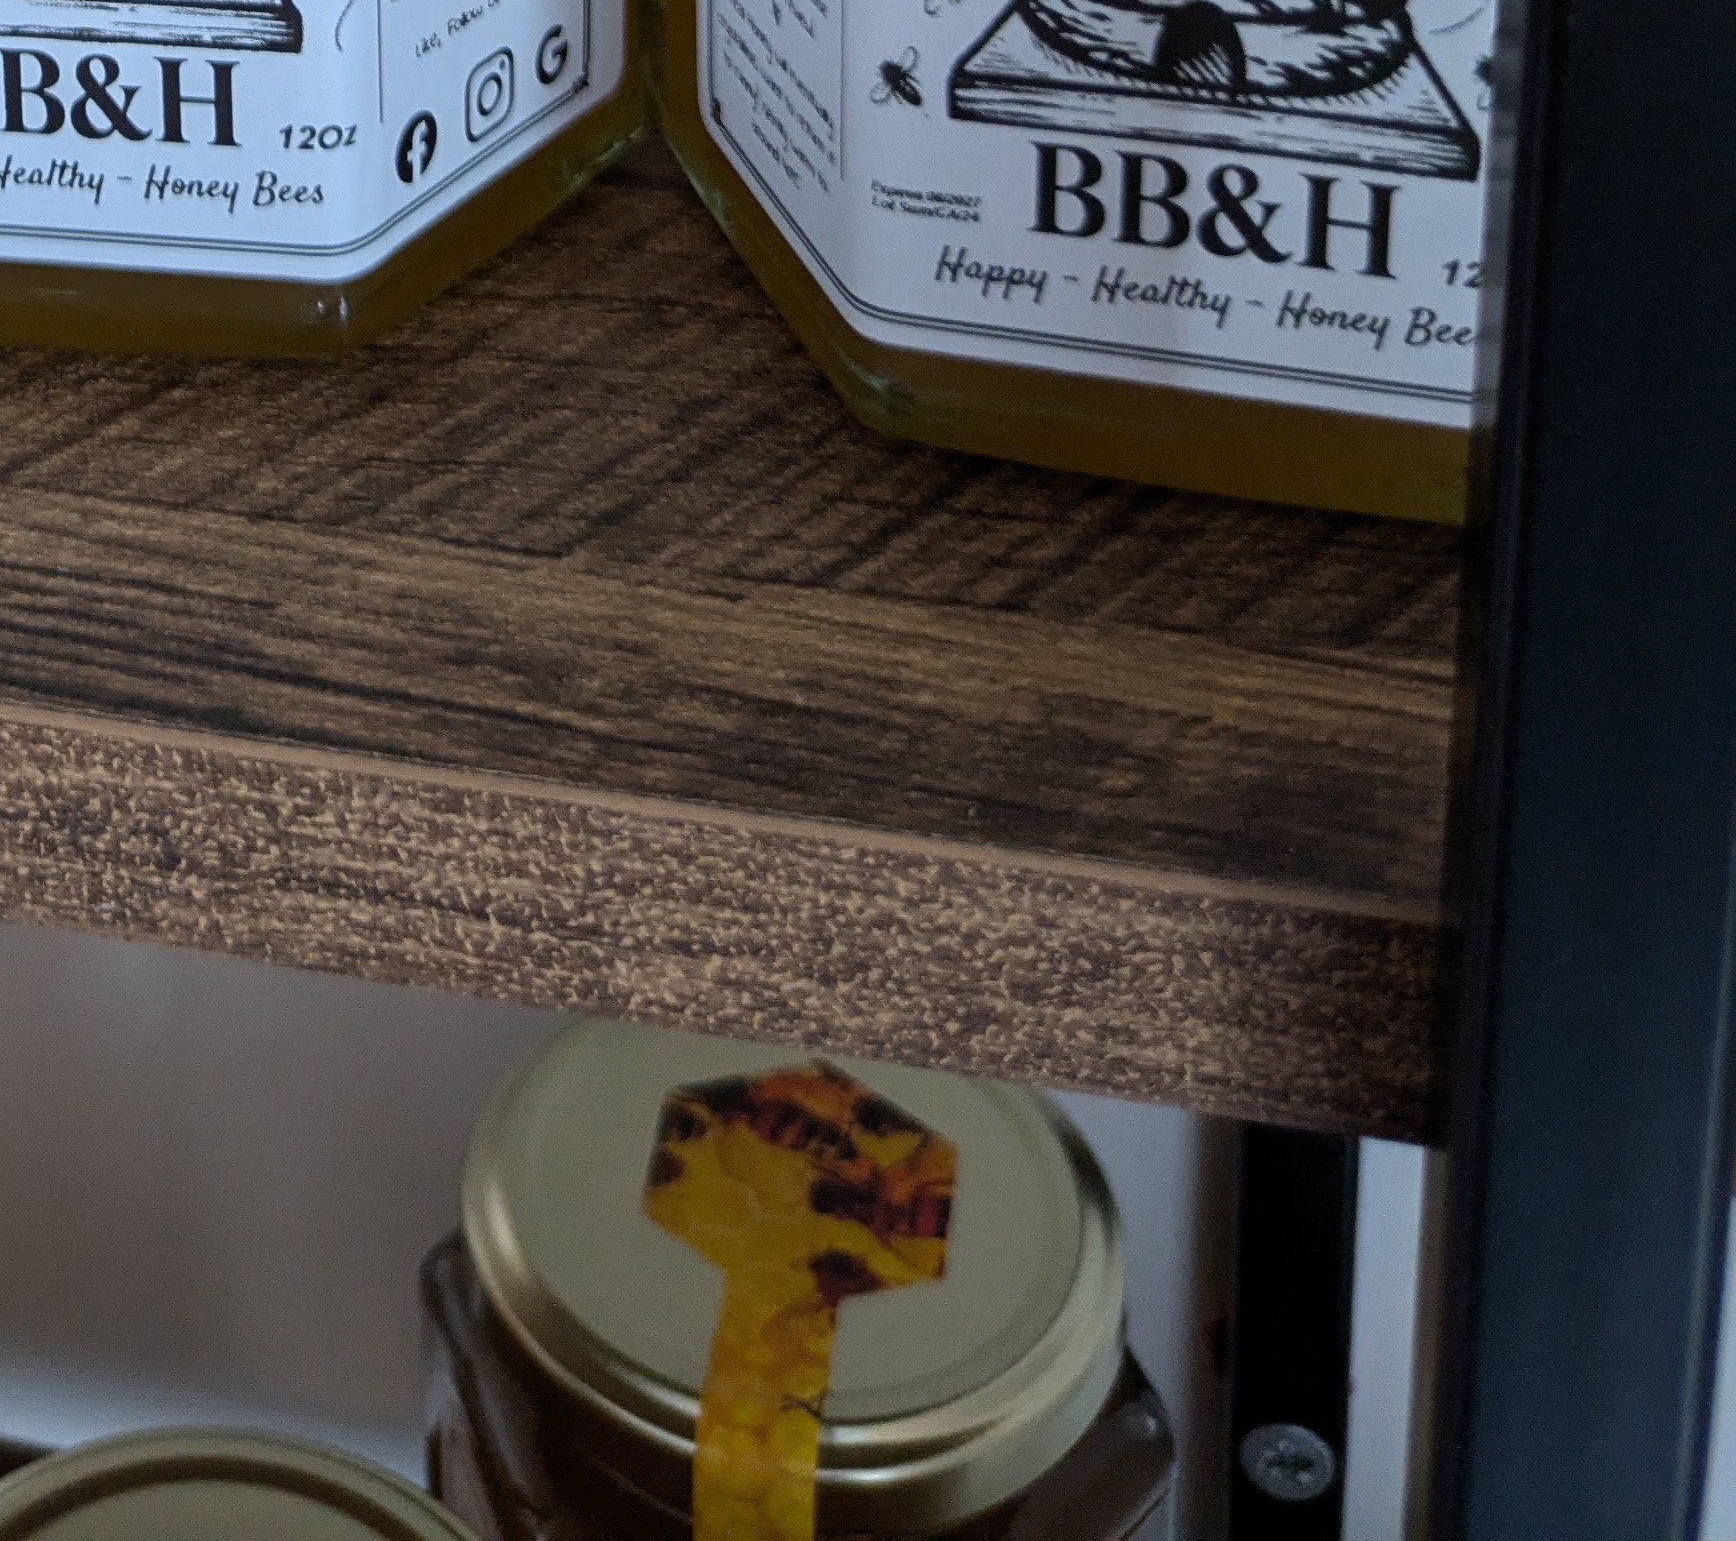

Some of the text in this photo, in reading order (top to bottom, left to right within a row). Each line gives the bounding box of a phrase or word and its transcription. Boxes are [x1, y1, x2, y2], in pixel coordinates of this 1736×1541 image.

[415, 32, 441, 57] Like,
[447, 4, 483, 36] Follow
[144, 163, 239, 213] Honey
[251, 170, 324, 208] Bees
[1027, 138, 1402, 279] BB&H
[935, 245, 1047, 303] Happy
[1091, 265, 1233, 327] Healthy
[1277, 289, 1390, 346] Honey
[1405, 307, 1474, 346] Bee
